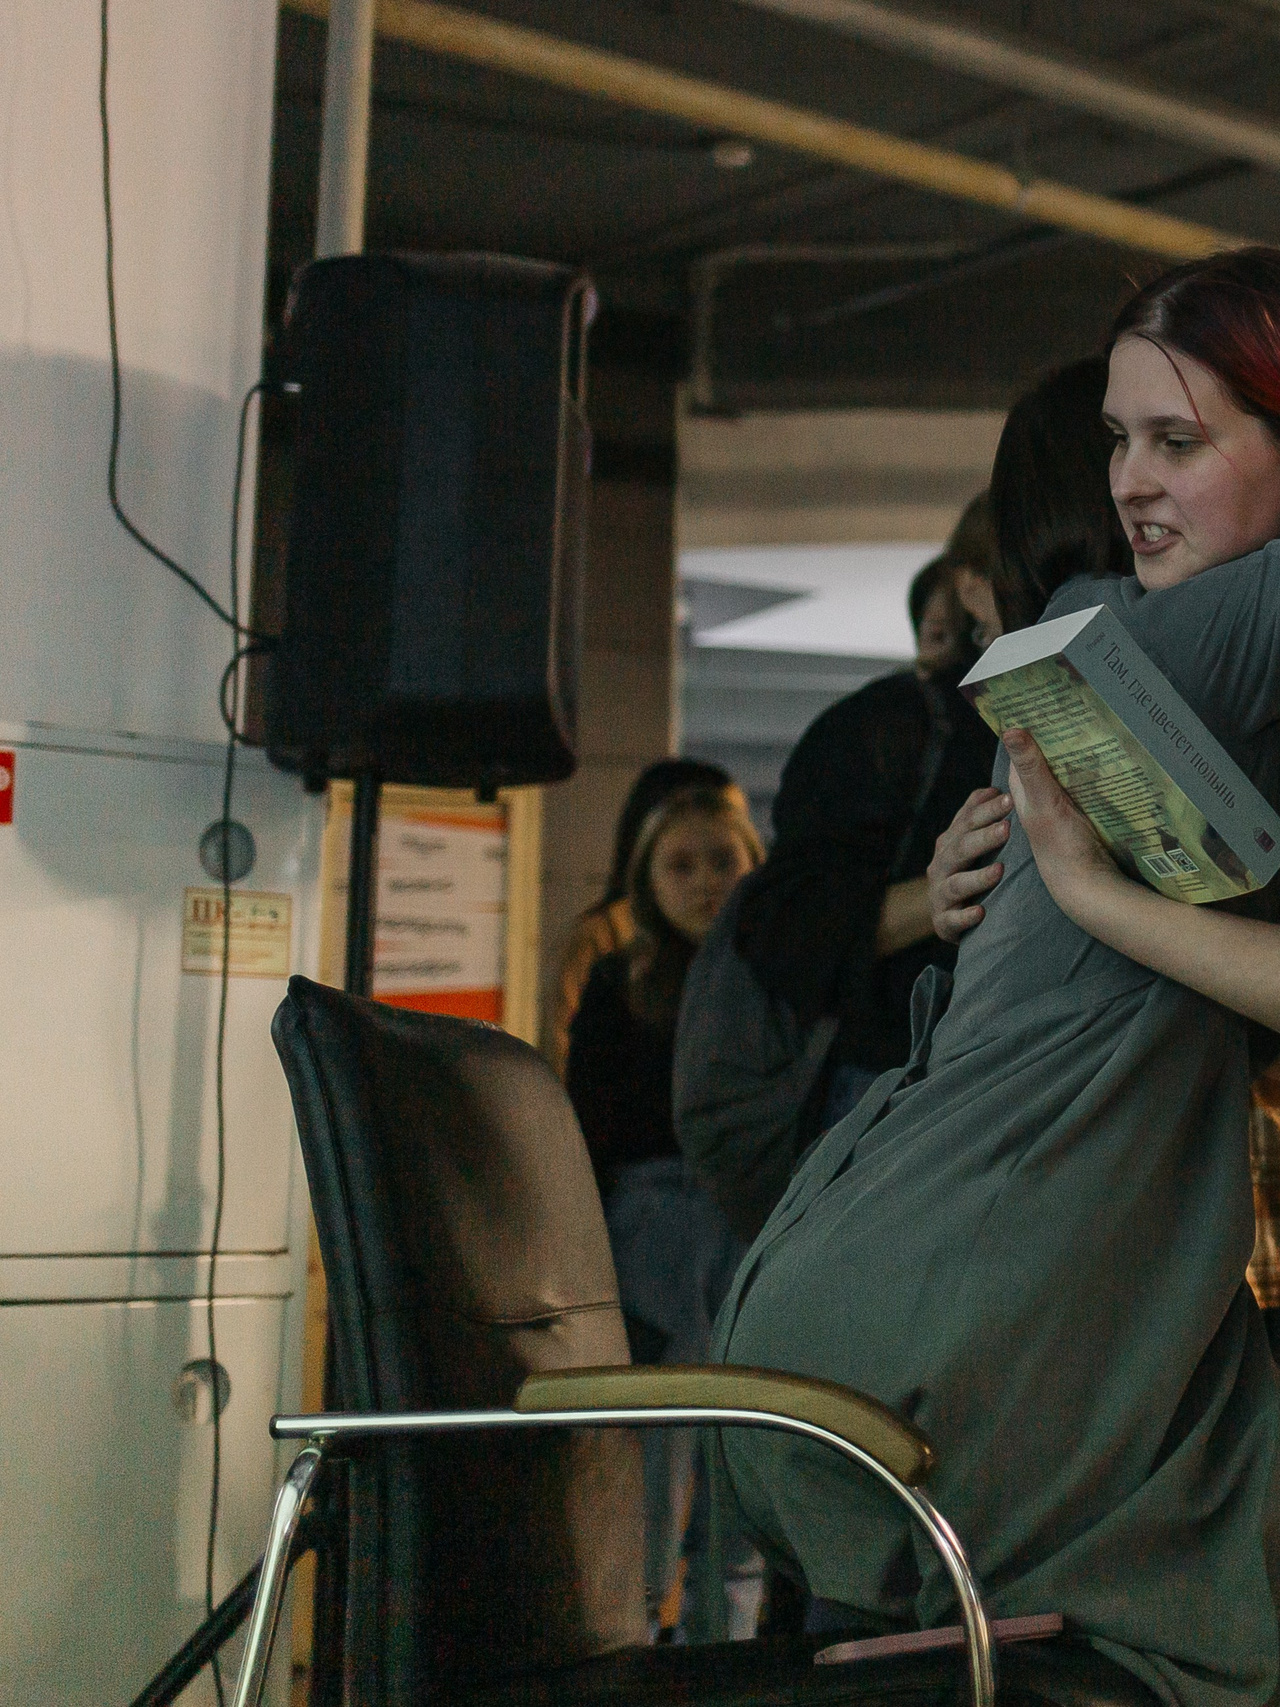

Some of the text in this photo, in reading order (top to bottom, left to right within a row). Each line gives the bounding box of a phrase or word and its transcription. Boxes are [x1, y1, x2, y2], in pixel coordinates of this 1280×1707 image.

[1103, 642, 1236, 809] Там, где цветет полынь
